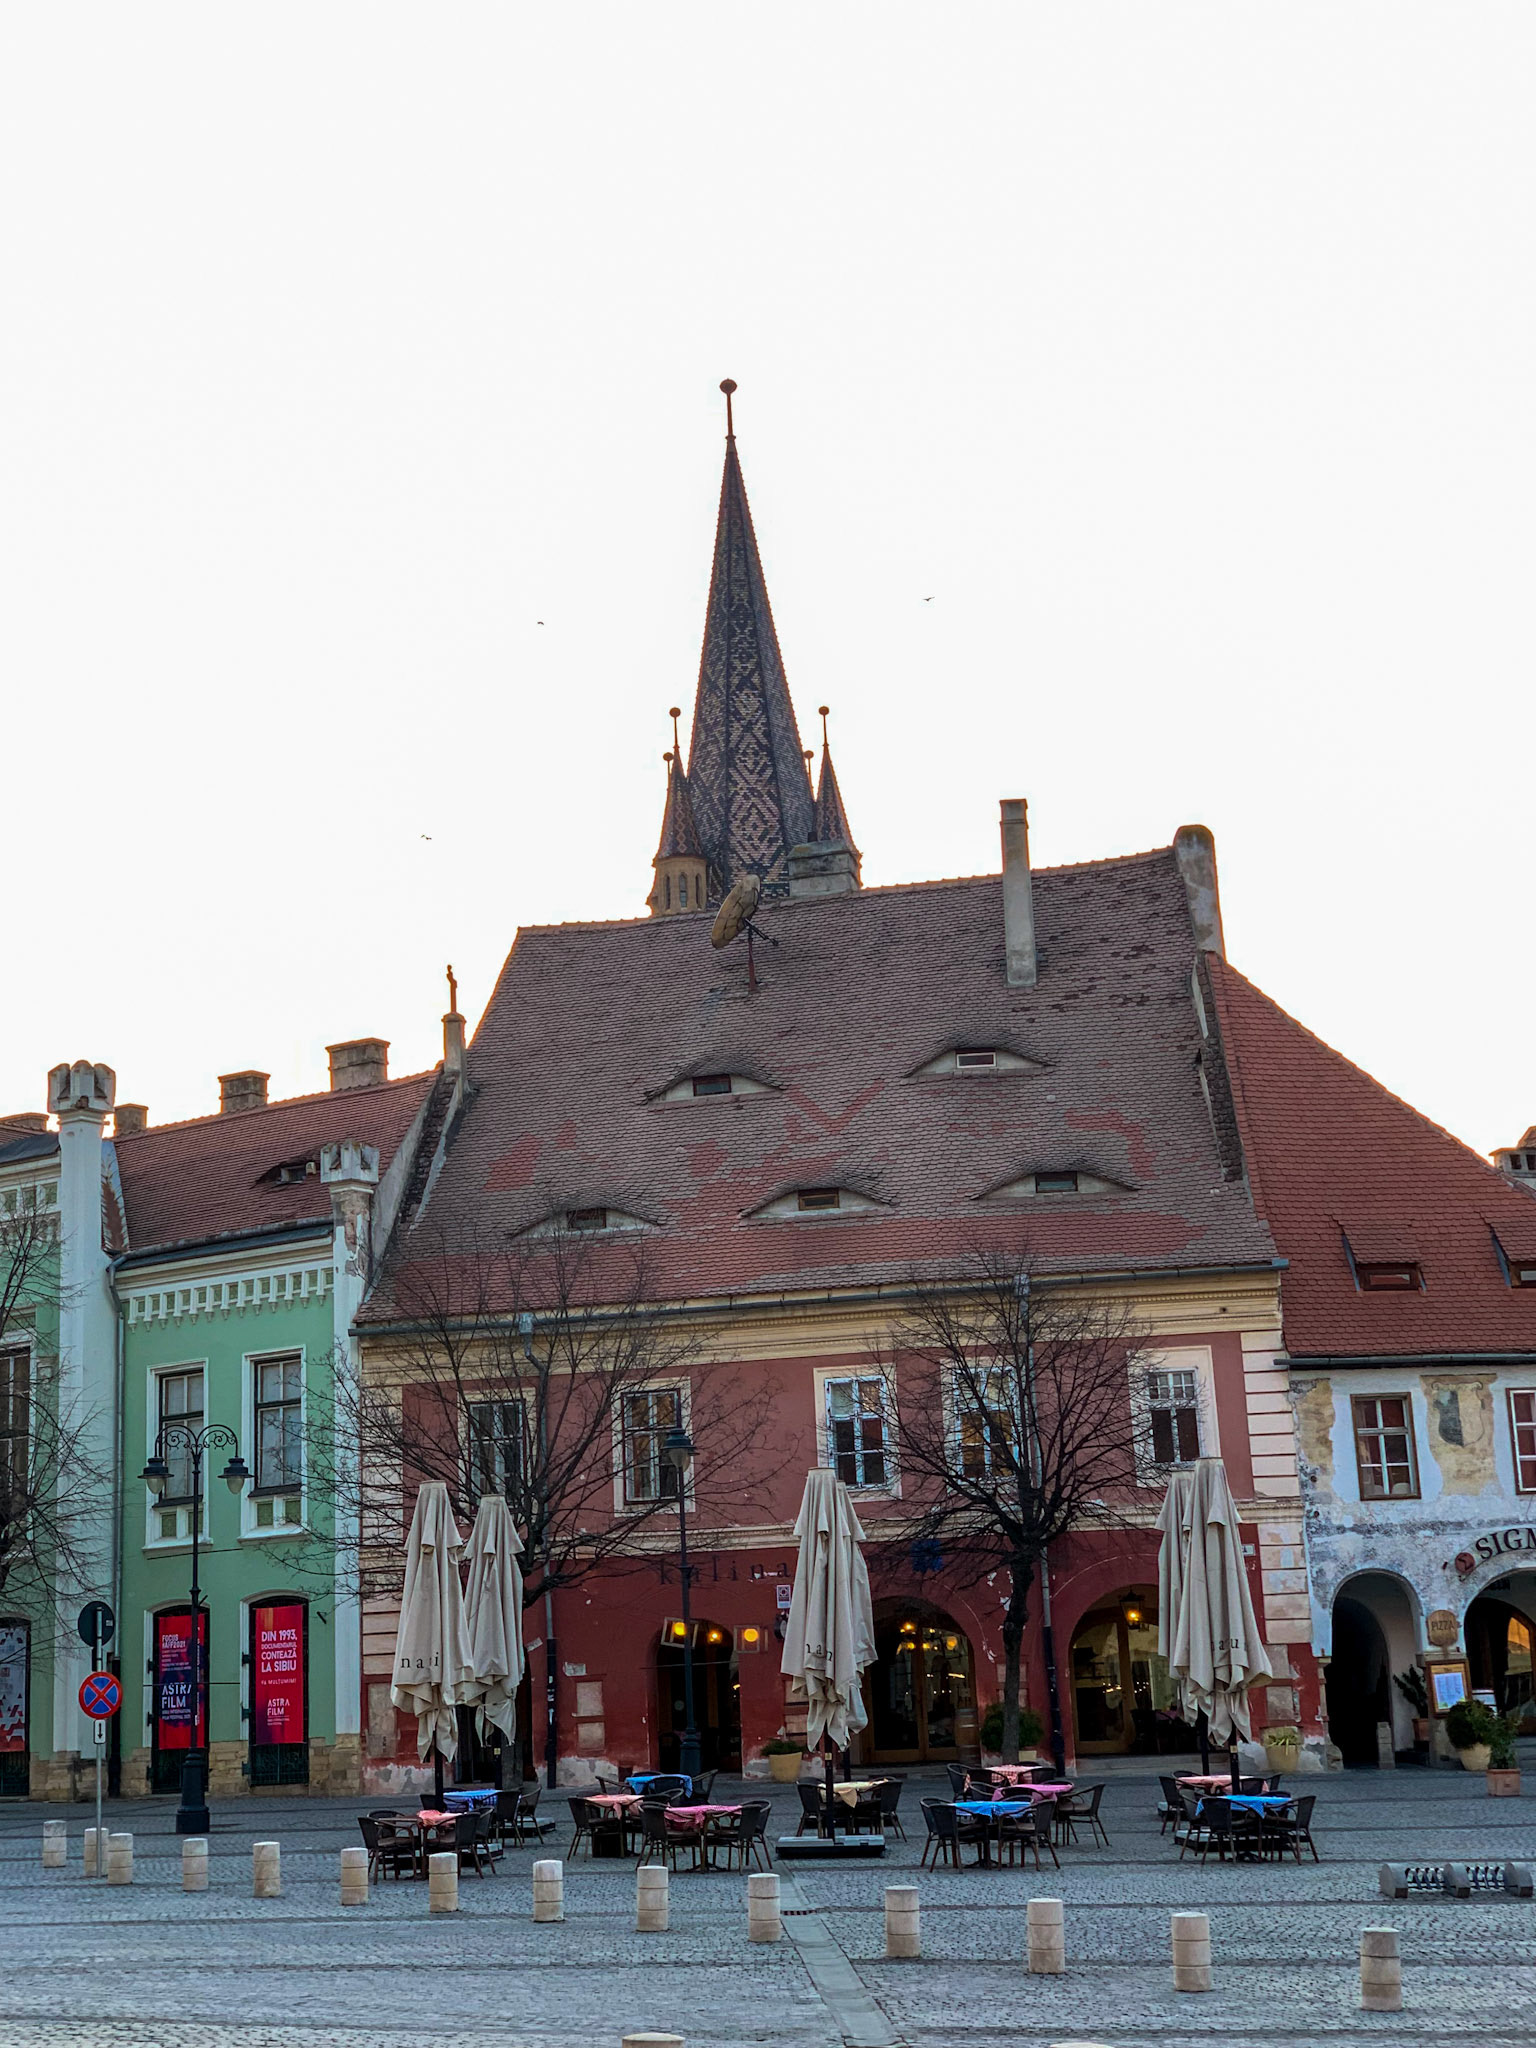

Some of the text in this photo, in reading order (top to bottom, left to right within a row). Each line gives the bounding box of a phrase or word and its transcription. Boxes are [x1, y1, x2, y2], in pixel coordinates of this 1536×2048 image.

[1431, 1620, 1455, 1631] PIZZA
[262, 1629, 297, 1642] DIN 1993.
[261, 1648, 297, 1660] CONTEAZĂ
[262, 1660, 297, 1673] LA SIBIU
[162, 1696, 186, 1709] FILM
[267, 1698, 291, 1707] ASTRA
[267, 1707, 285, 1716] FILM
